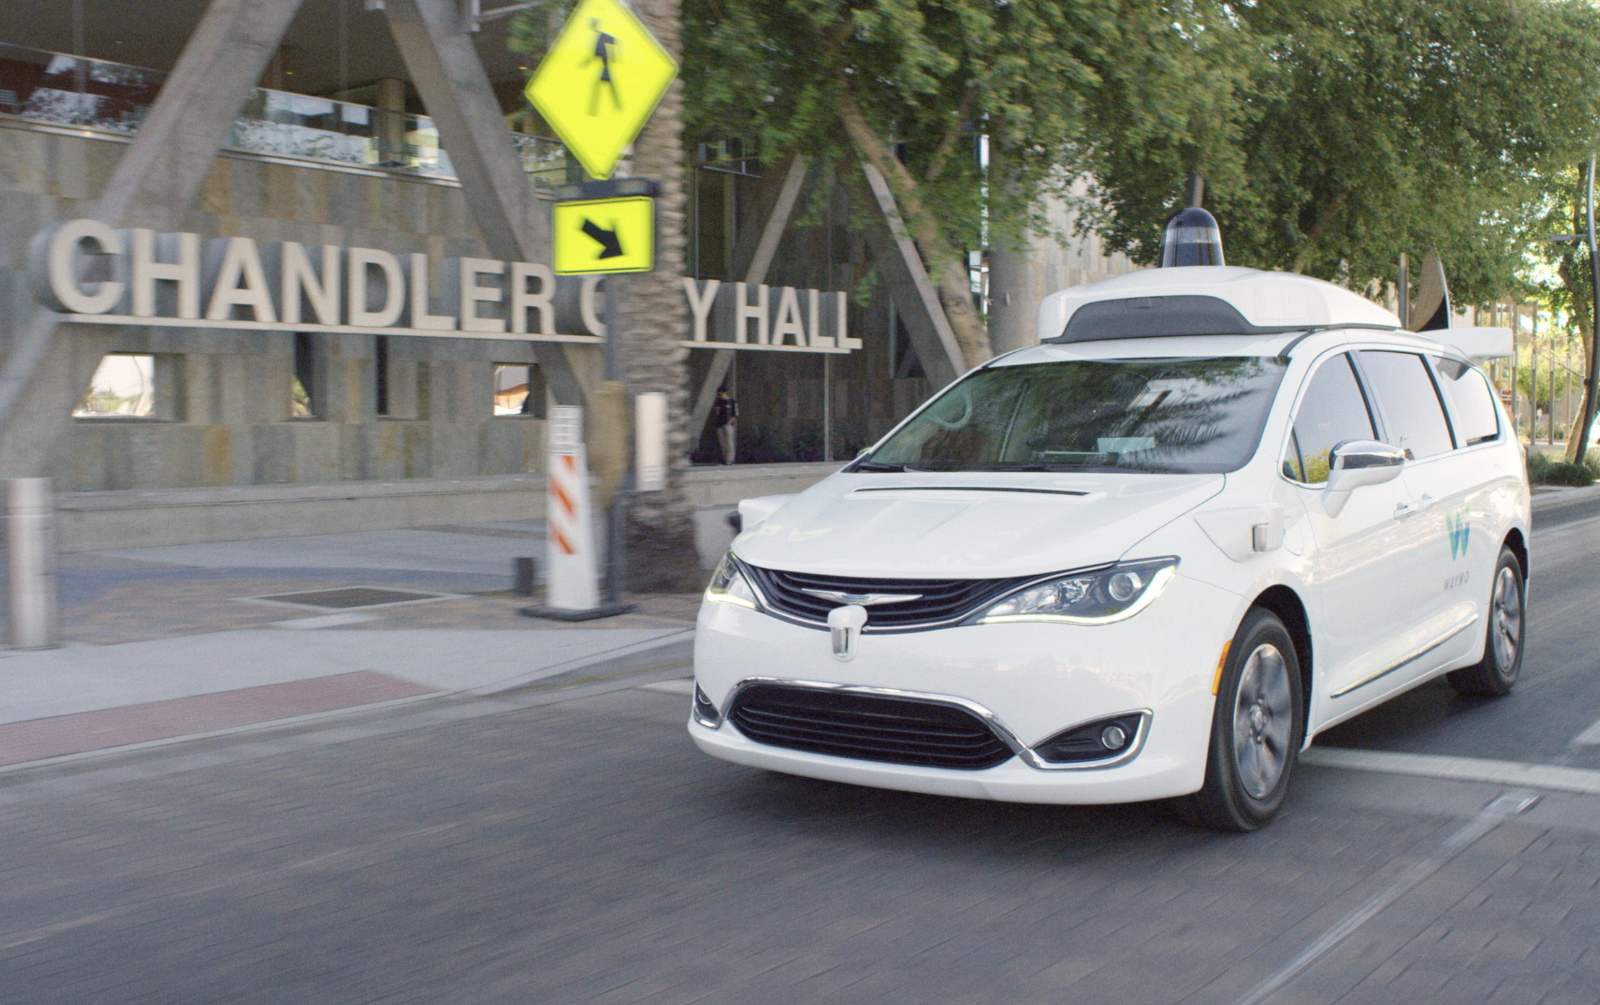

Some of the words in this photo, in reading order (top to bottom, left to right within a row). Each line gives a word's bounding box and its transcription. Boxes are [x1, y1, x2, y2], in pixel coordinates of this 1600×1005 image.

[48, 218, 557, 334] CHANDLER
[579, 273, 720, 342] CY
[736, 281, 863, 349] HALL
